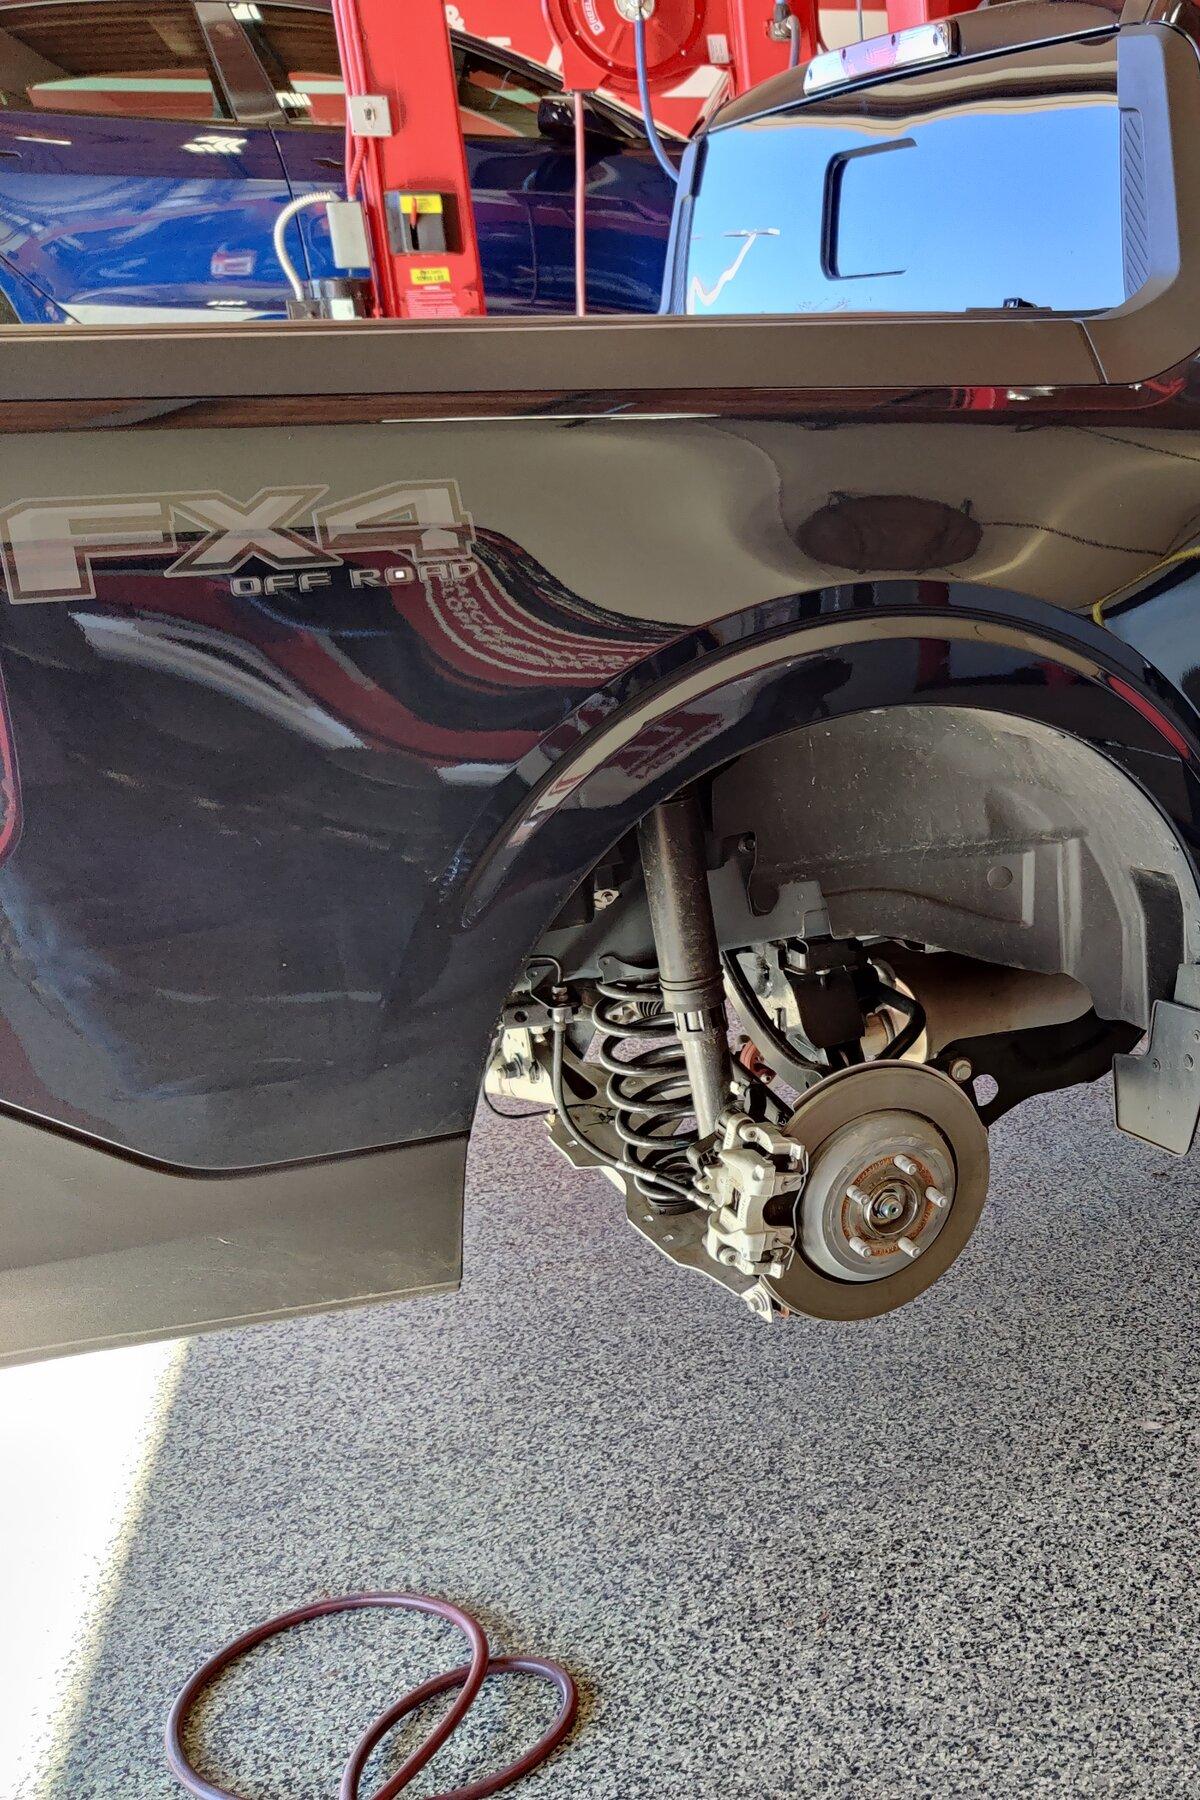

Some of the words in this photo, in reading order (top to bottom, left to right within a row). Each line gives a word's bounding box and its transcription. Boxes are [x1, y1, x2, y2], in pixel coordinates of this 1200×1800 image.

[0, 478, 475, 605] FX4
[230, 569, 332, 597] OFF
[351, 561, 479, 589] ROAD
